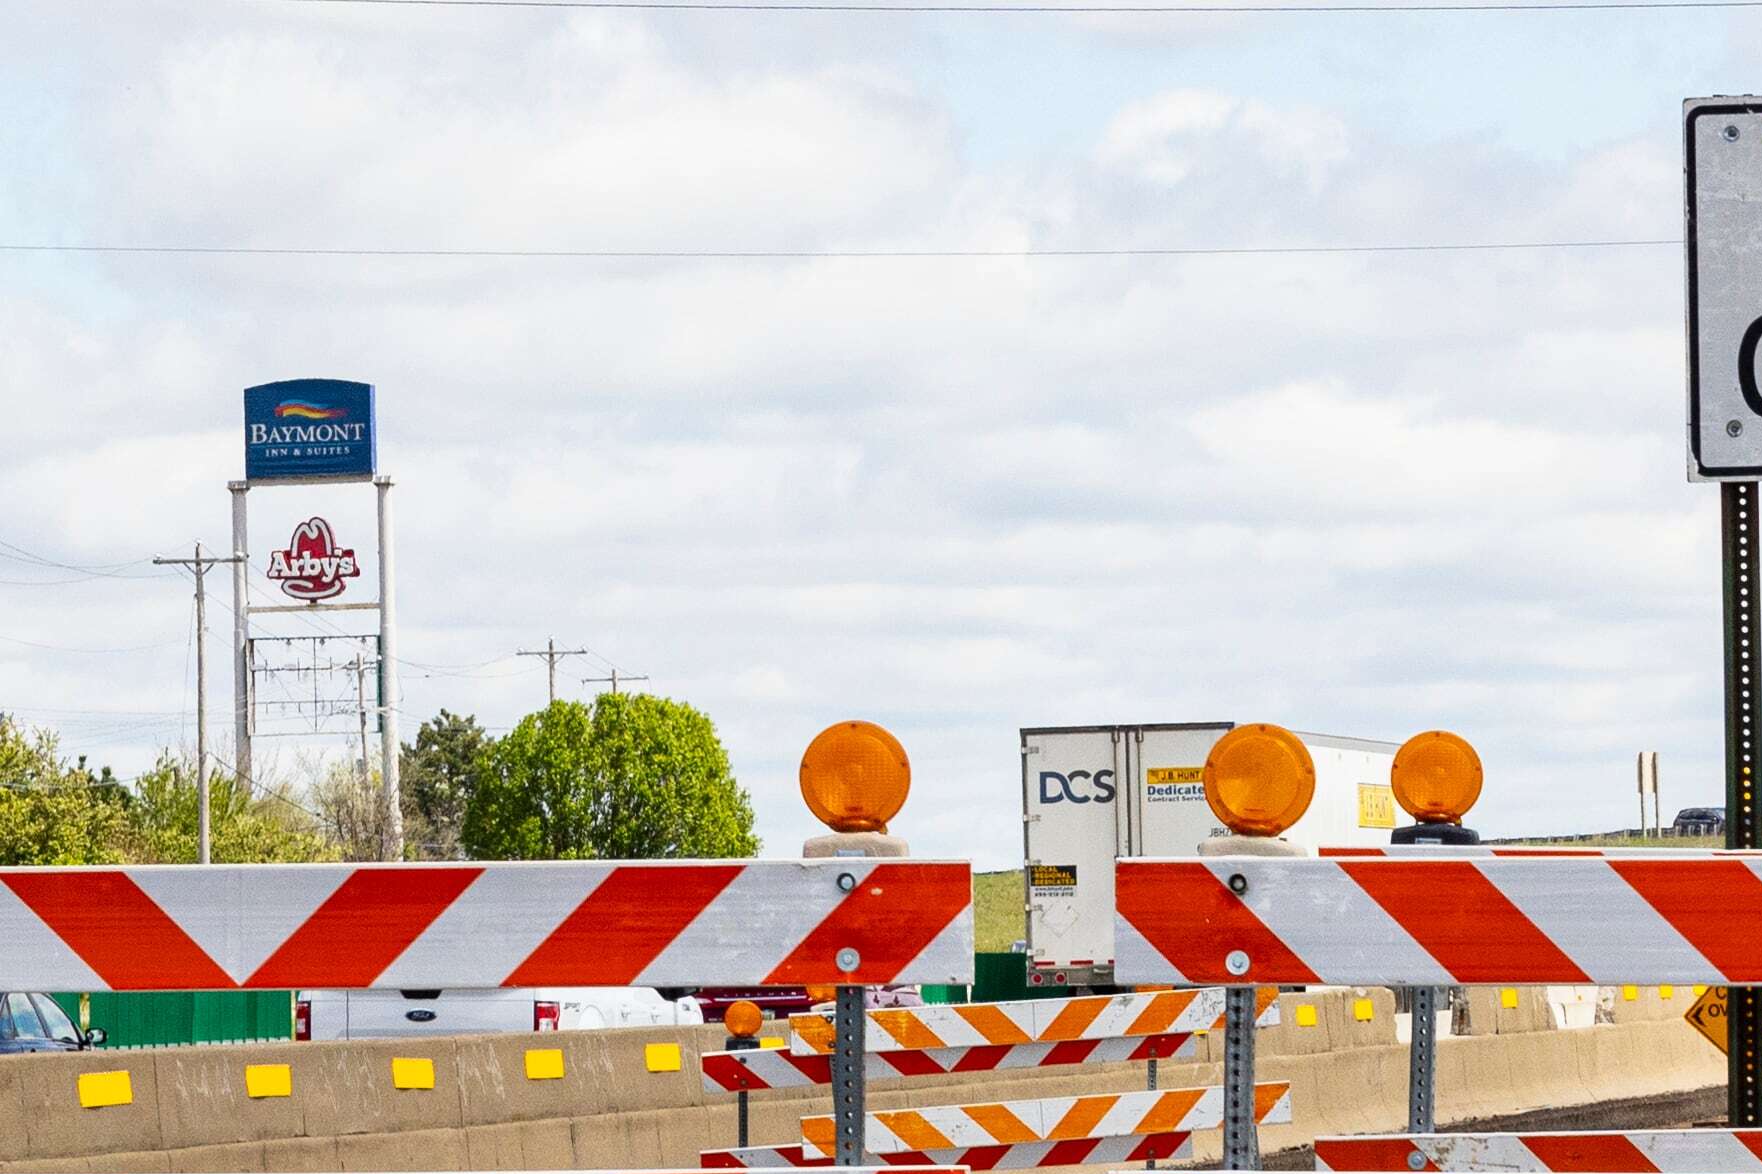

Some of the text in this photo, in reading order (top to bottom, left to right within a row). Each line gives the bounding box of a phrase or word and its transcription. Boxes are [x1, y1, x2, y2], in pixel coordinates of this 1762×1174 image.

[251, 423, 365, 444] BAYMONT
[265, 445, 351, 457] INN & SUITES
[268, 548, 355, 582] Arby's
[1177, 770, 1200, 781] HUNT
[1039, 769, 1116, 804] DCS
[1147, 784, 1205, 795] Dedicate
